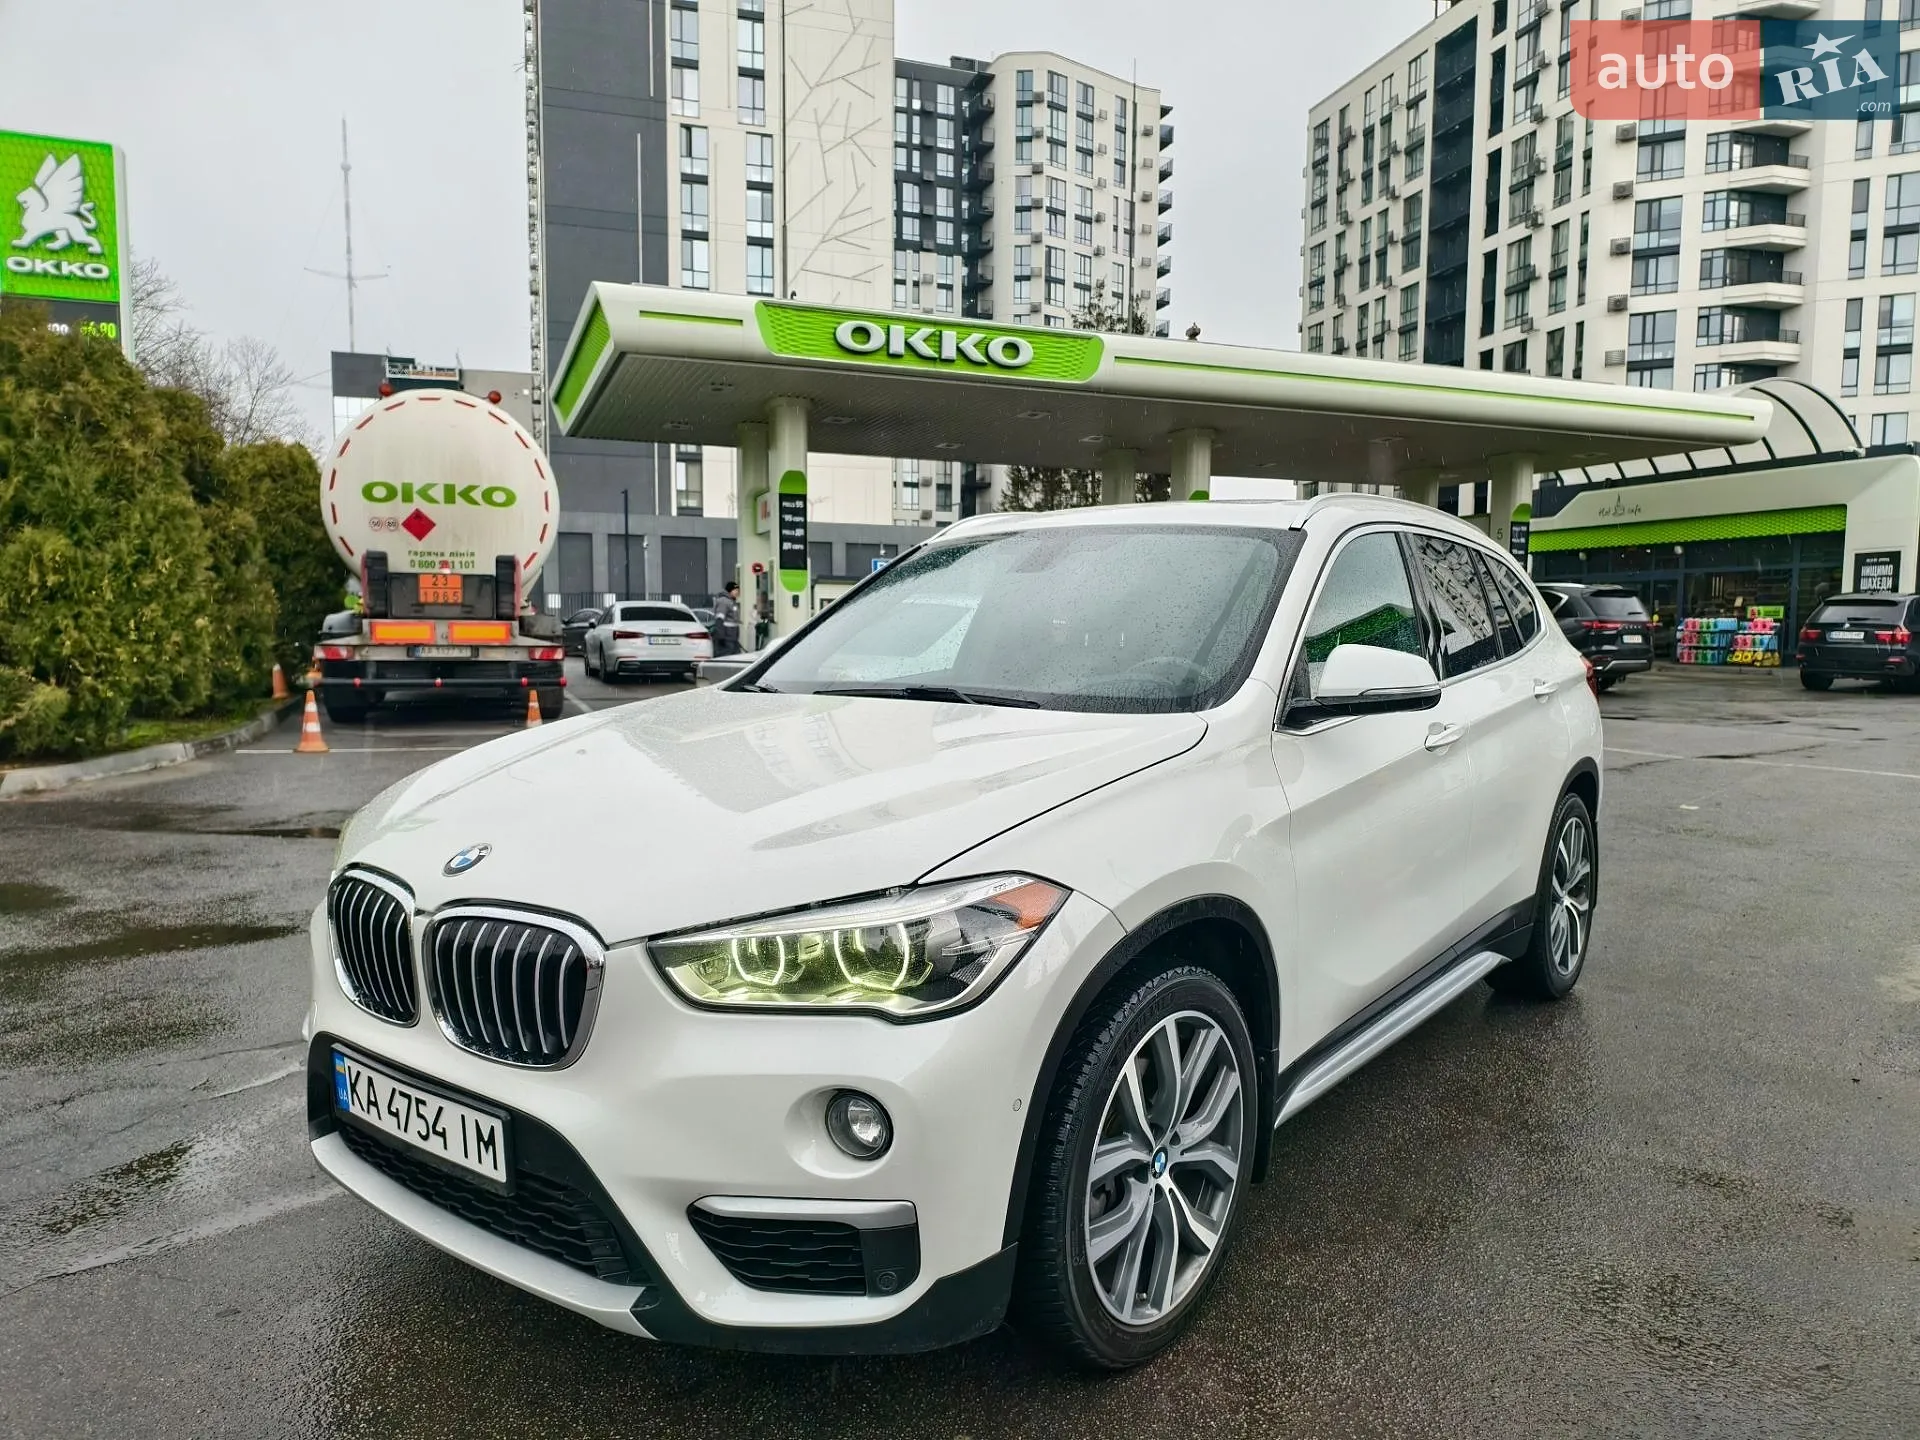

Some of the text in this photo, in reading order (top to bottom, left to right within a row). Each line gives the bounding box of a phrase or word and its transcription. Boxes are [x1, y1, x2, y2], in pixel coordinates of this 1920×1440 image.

[6, 256, 110, 280] OKKO
[834, 320, 1034, 368] OKKO
[361, 480, 518, 508] OKKO
[1496, 528, 1504, 540] 5
[408, 549, 476, 558] гаряча лінія
[458, 560, 475, 569] 101
[432, 574, 448, 587] 23
[347, 1065, 498, 1171] KA 4754 IM
